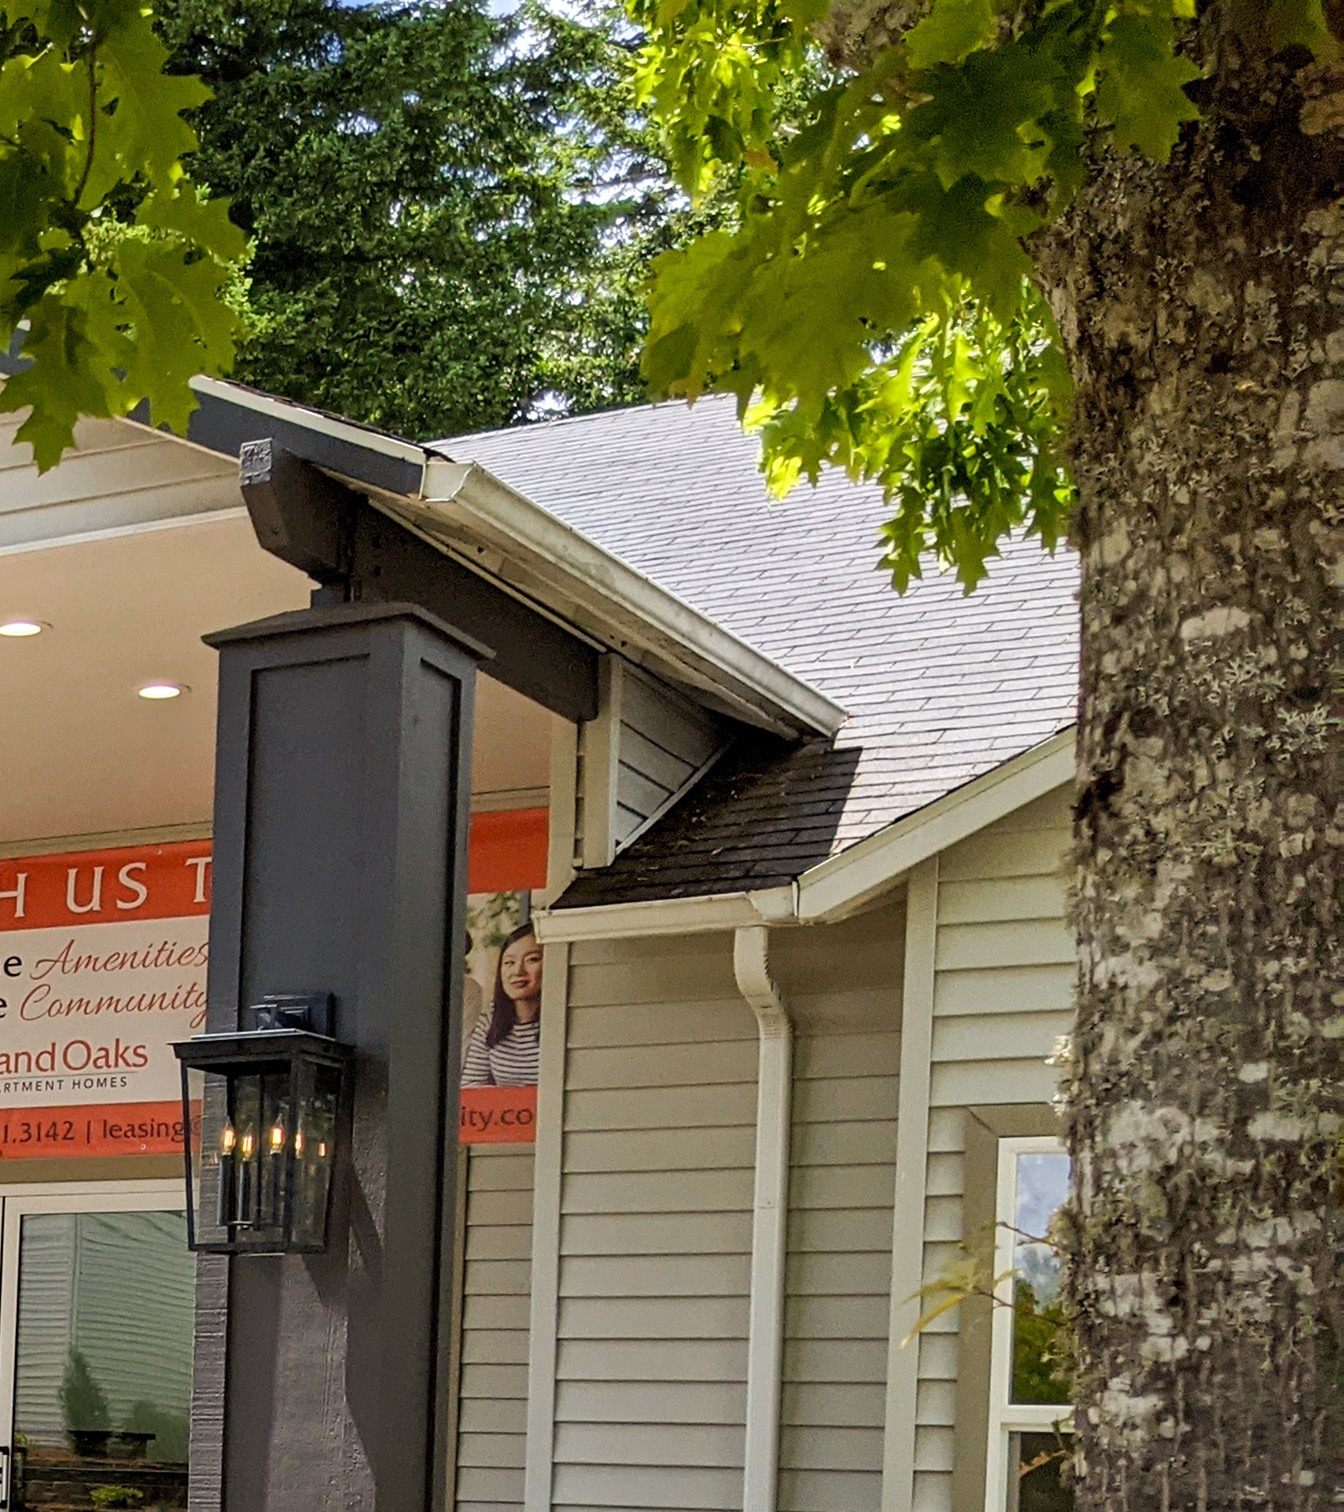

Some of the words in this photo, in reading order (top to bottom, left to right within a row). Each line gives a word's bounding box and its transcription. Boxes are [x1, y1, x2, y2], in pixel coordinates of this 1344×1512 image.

[65, 861, 149, 914] US
[185, 856, 211, 903] T
[29, 939, 209, 980] Amenities
[19, 982, 208, 1029] Community
[71, 1076, 128, 1090] HOMES
[460, 1105, 533, 1132] ity.co
